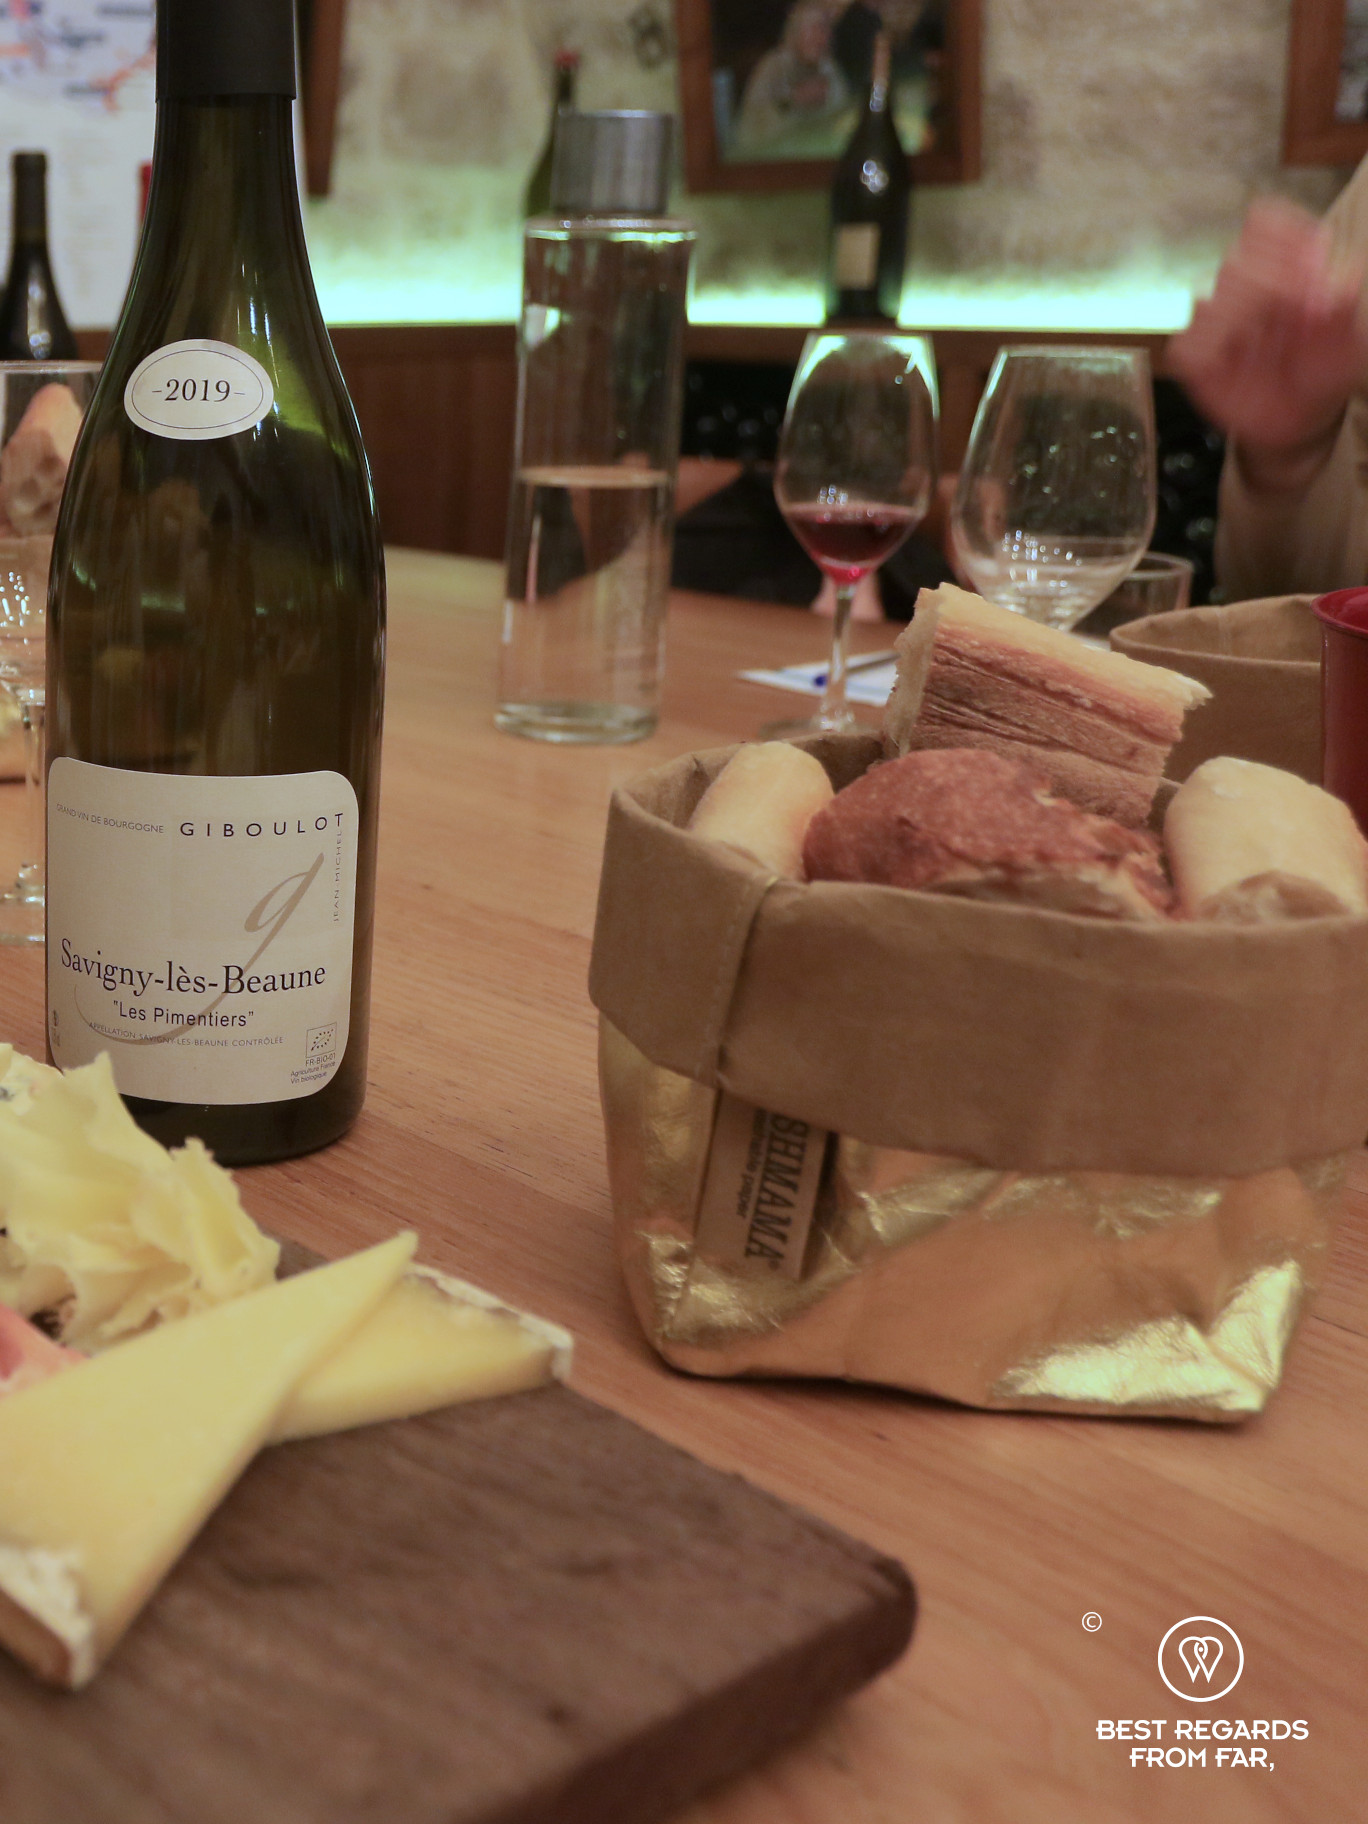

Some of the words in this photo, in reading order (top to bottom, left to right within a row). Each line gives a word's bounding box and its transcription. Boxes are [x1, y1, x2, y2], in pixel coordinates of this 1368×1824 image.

[78, 811, 89, 821] VIN
[91, 814, 102, 824] DE
[104, 817, 164, 834] BOURGOGNE
[180, 812, 344, 838] GIBOULOT
[61, 938, 327, 996] Savigny-lès-Beaune
[89, 1021, 136, 1039] APPELLATION
